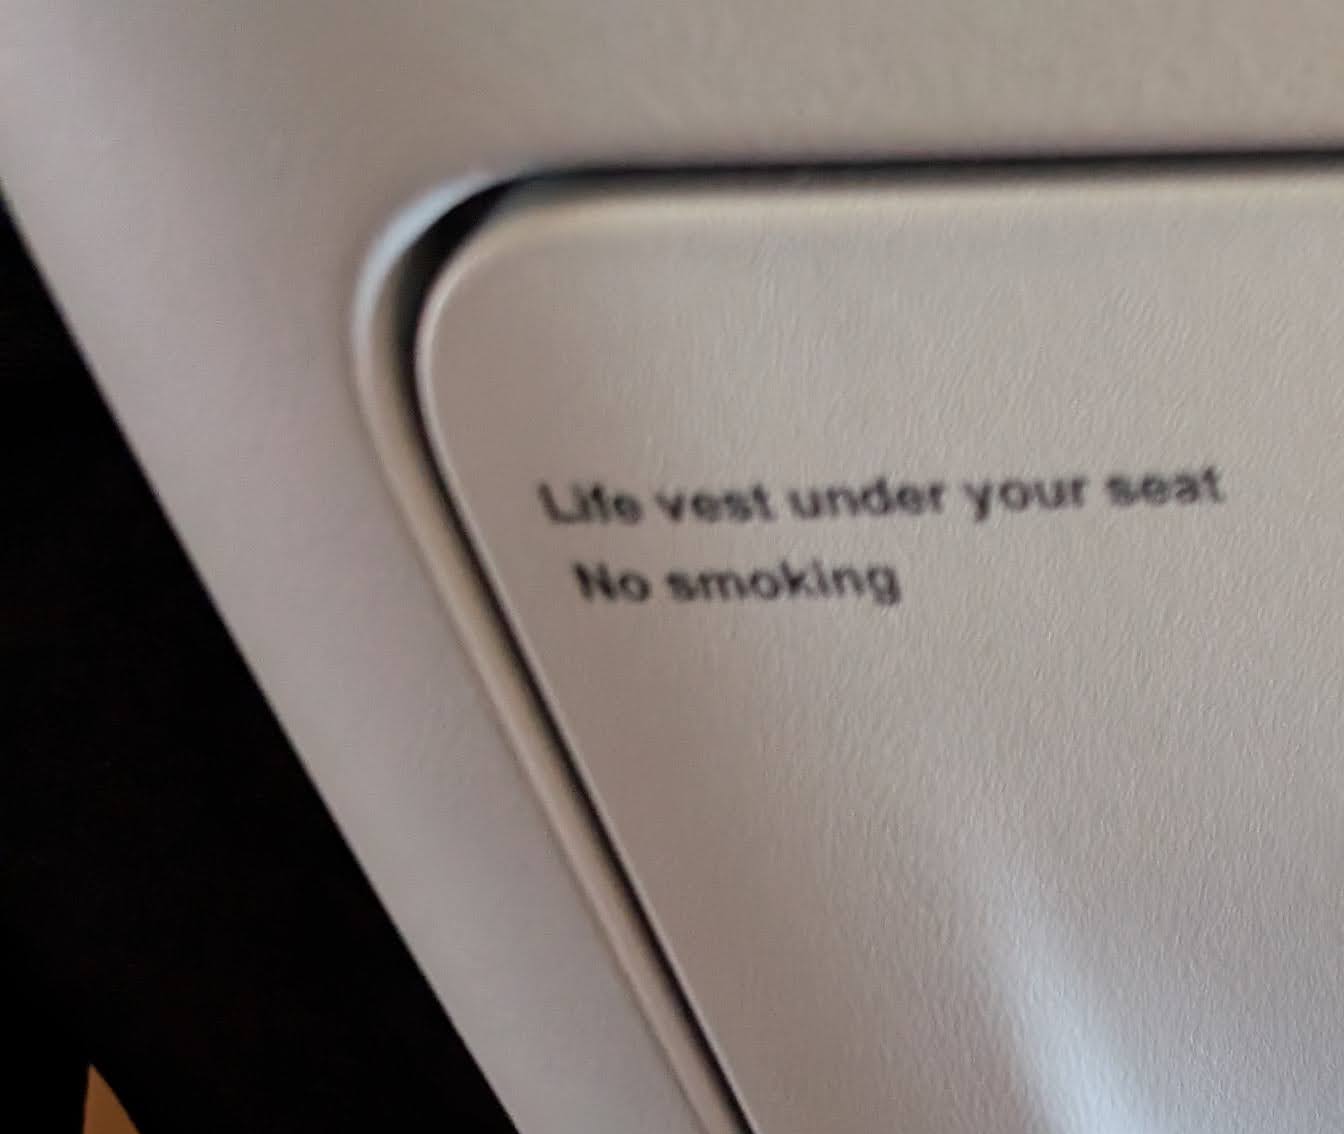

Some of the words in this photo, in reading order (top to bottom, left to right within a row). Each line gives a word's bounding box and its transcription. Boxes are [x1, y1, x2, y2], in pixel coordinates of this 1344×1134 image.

[537, 483, 644, 526] Life
[656, 482, 778, 524] vest
[788, 478, 946, 520] under
[960, 474, 1090, 522] your
[1107, 465, 1226, 507] seat
[574, 562, 650, 602] No
[666, 559, 902, 606] smoking
